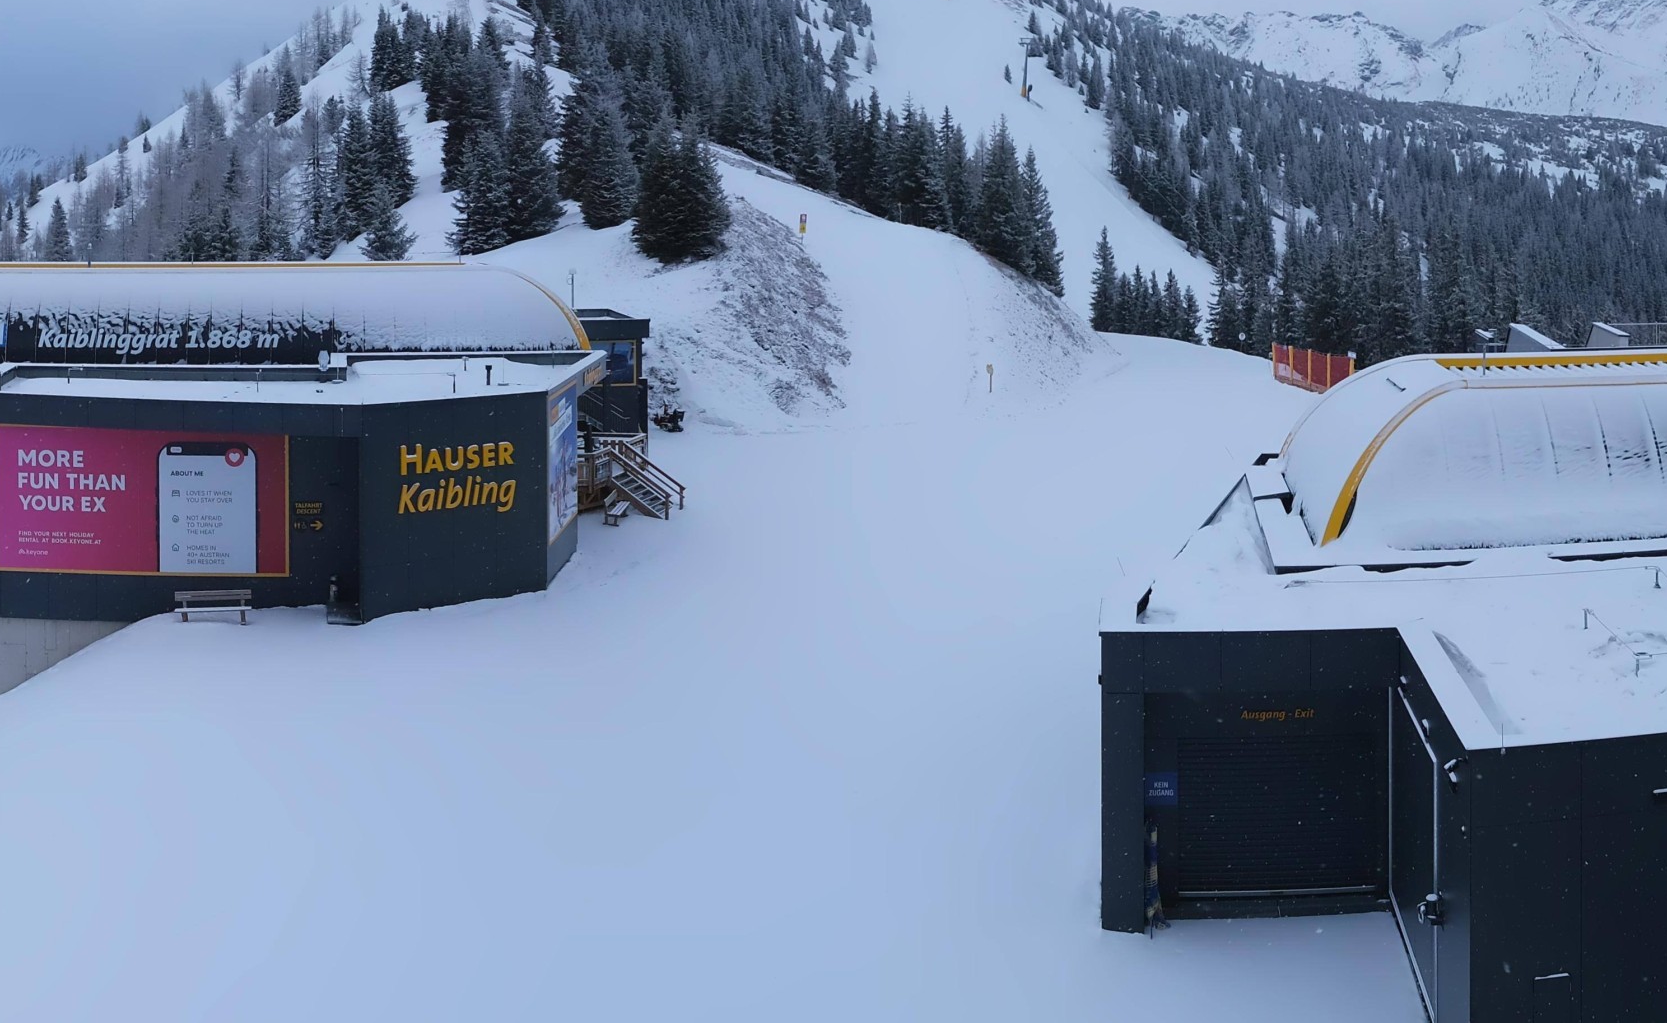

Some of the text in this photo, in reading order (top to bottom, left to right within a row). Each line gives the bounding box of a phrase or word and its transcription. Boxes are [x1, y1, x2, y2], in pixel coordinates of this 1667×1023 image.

[38, 328, 279, 355] Kaiblinggrat 1.868 m
[17, 449, 84, 468] MORE
[399, 441, 514, 476] HAUSER
[18, 472, 126, 491] FUN THAN
[19, 495, 106, 512] YOUR EX
[397, 475, 517, 514] Kaibling
[1240, 709, 1287, 722] Ausgang
[1294, 708, 1315, 719] Exit
[1149, 789, 1174, 797] ZUGANG
[1153, 781, 1169, 789] KEIN
